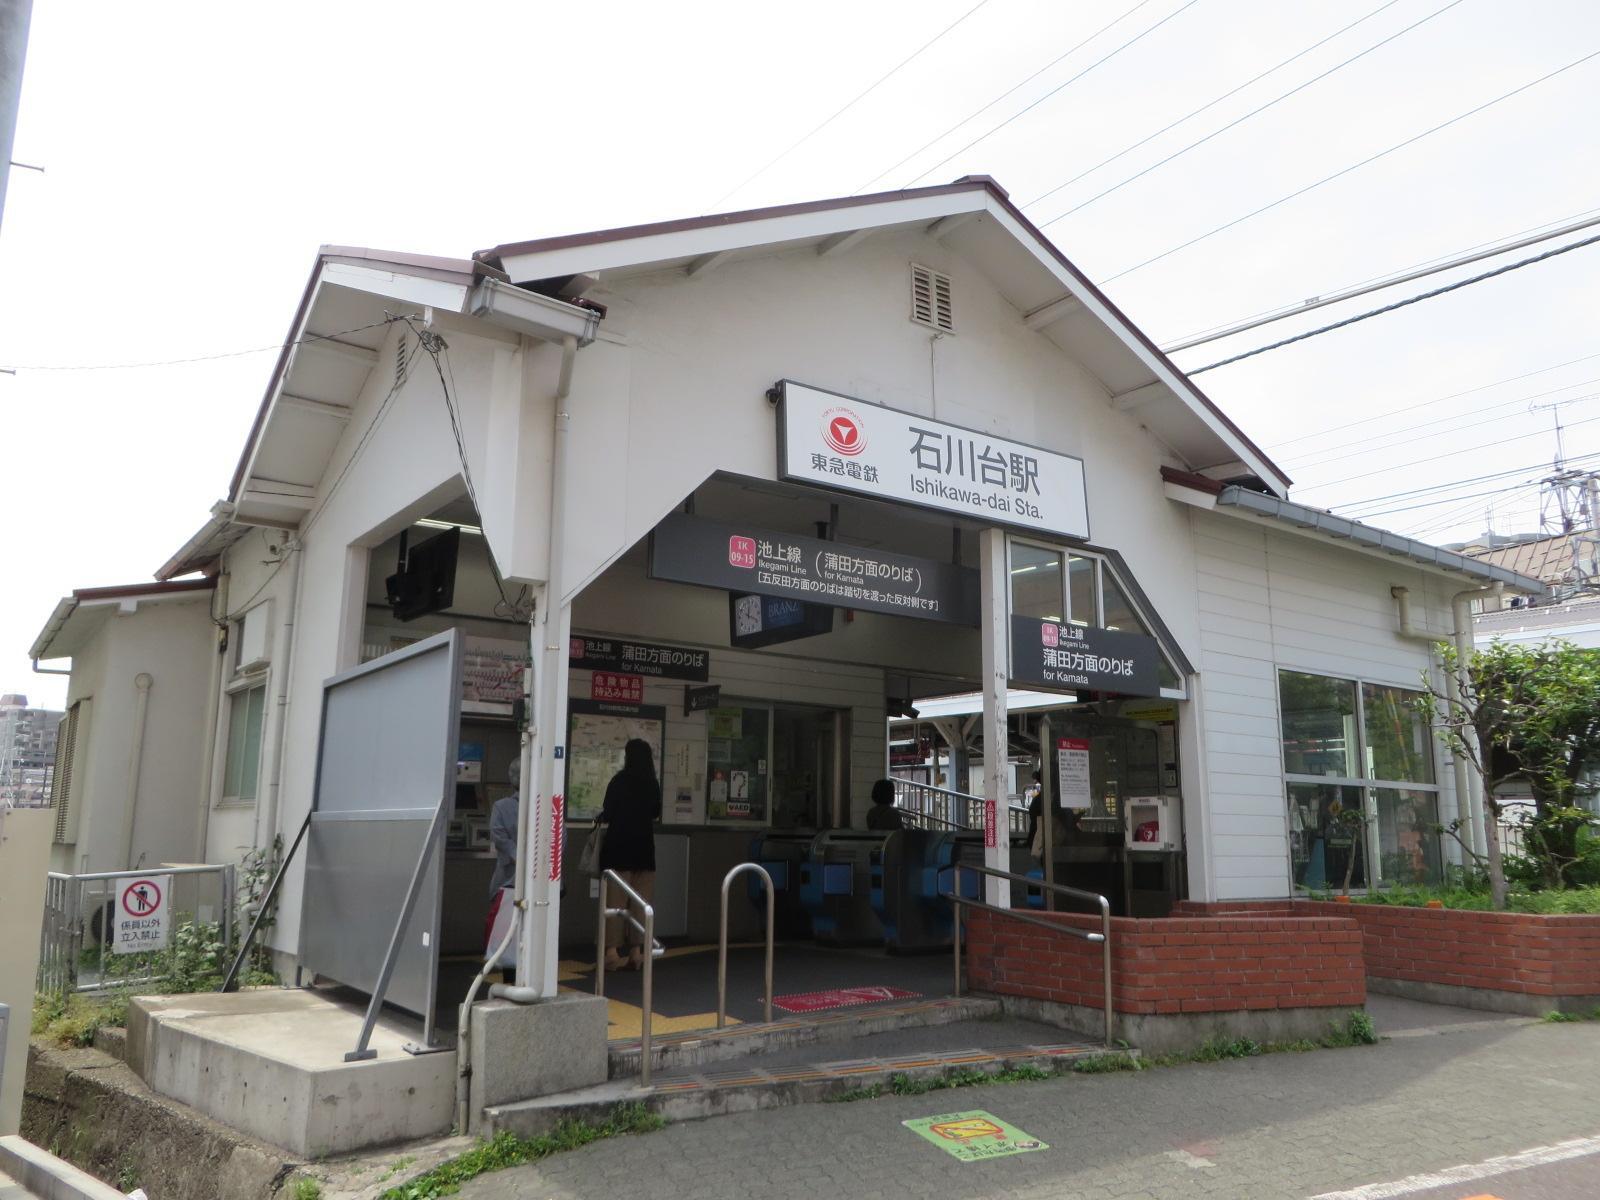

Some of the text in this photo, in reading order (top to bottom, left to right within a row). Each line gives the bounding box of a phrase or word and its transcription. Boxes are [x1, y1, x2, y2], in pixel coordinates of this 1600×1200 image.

[811, 453, 879, 483] 東急電鉄
[909, 426, 1041, 496] 石川台駅
[911, 474, 1044, 520] Ishikawa-dai Sta.
[731, 552, 754, 564] 09-15
[758, 540, 802, 563] 池上線
[758, 559, 807, 575] Ikegami Line
[824, 571, 864, 585] for Kamata
[1059, 625, 1083, 640] 池上線
[622, 645, 704, 667] 蒲田方面のりば
[1043, 648, 1134, 676] 蒲田方面のりば
[622, 662, 663, 674] for Kamata
[1043, 669, 1089, 684] for Kamata
[121, 918, 160, 930] 係員以外
[119, 930, 161, 941] 立入禁止
